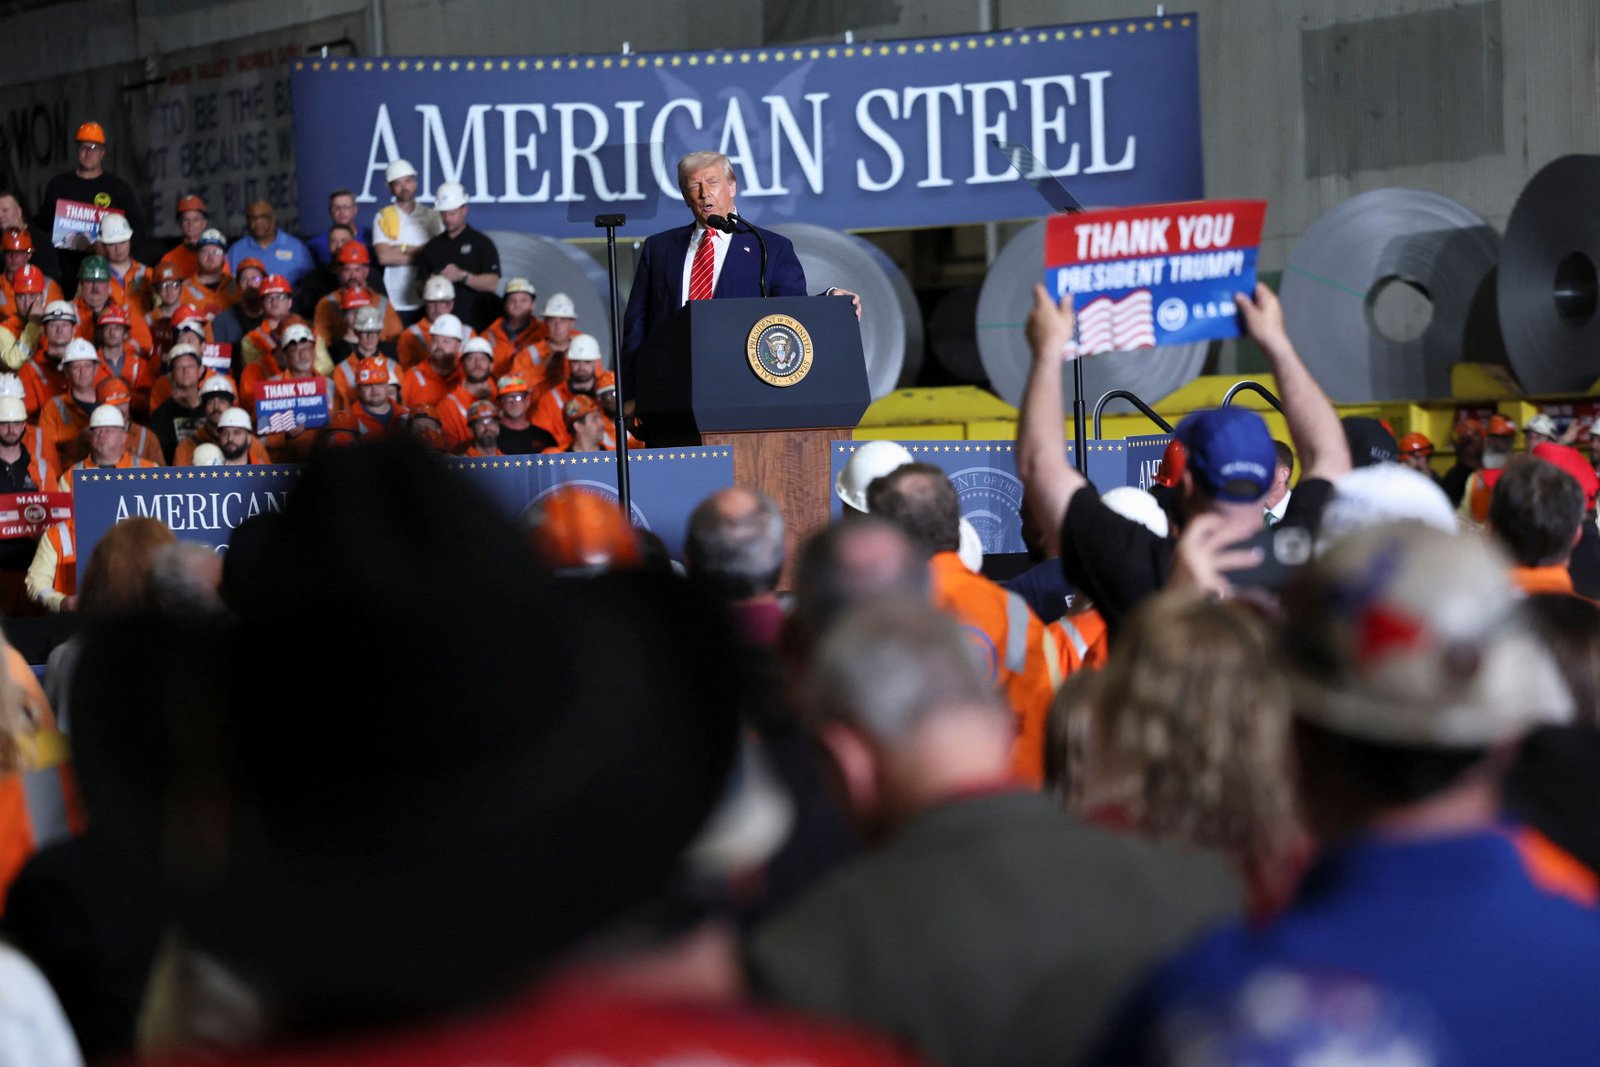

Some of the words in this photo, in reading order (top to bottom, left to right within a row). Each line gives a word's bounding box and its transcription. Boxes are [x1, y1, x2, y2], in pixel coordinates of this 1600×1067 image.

[355, 92, 831, 203] AMERICAN
[855, 70, 1136, 192] STEEL
[65, 204, 97, 222] THANK
[1074, 215, 1172, 261] THANK
[1177, 212, 1235, 250] YOU
[1056, 255, 1167, 297] PRESIDENT
[1168, 250, 1244, 284] TRUMP!
[749, 316, 776, 349] PRESIDENT
[794, 324, 811, 354] UNITED
[788, 360, 810, 383] STATES
[263, 382, 296, 400] THANK
[296, 381, 316, 396] YOU
[259, 397, 296, 412] PRESIDENT
[983, 474, 997, 485] OF
[1000, 478, 1018, 495] THE
[16, 494, 49, 505] MAKE
[2, 524, 37, 536] GREAT
